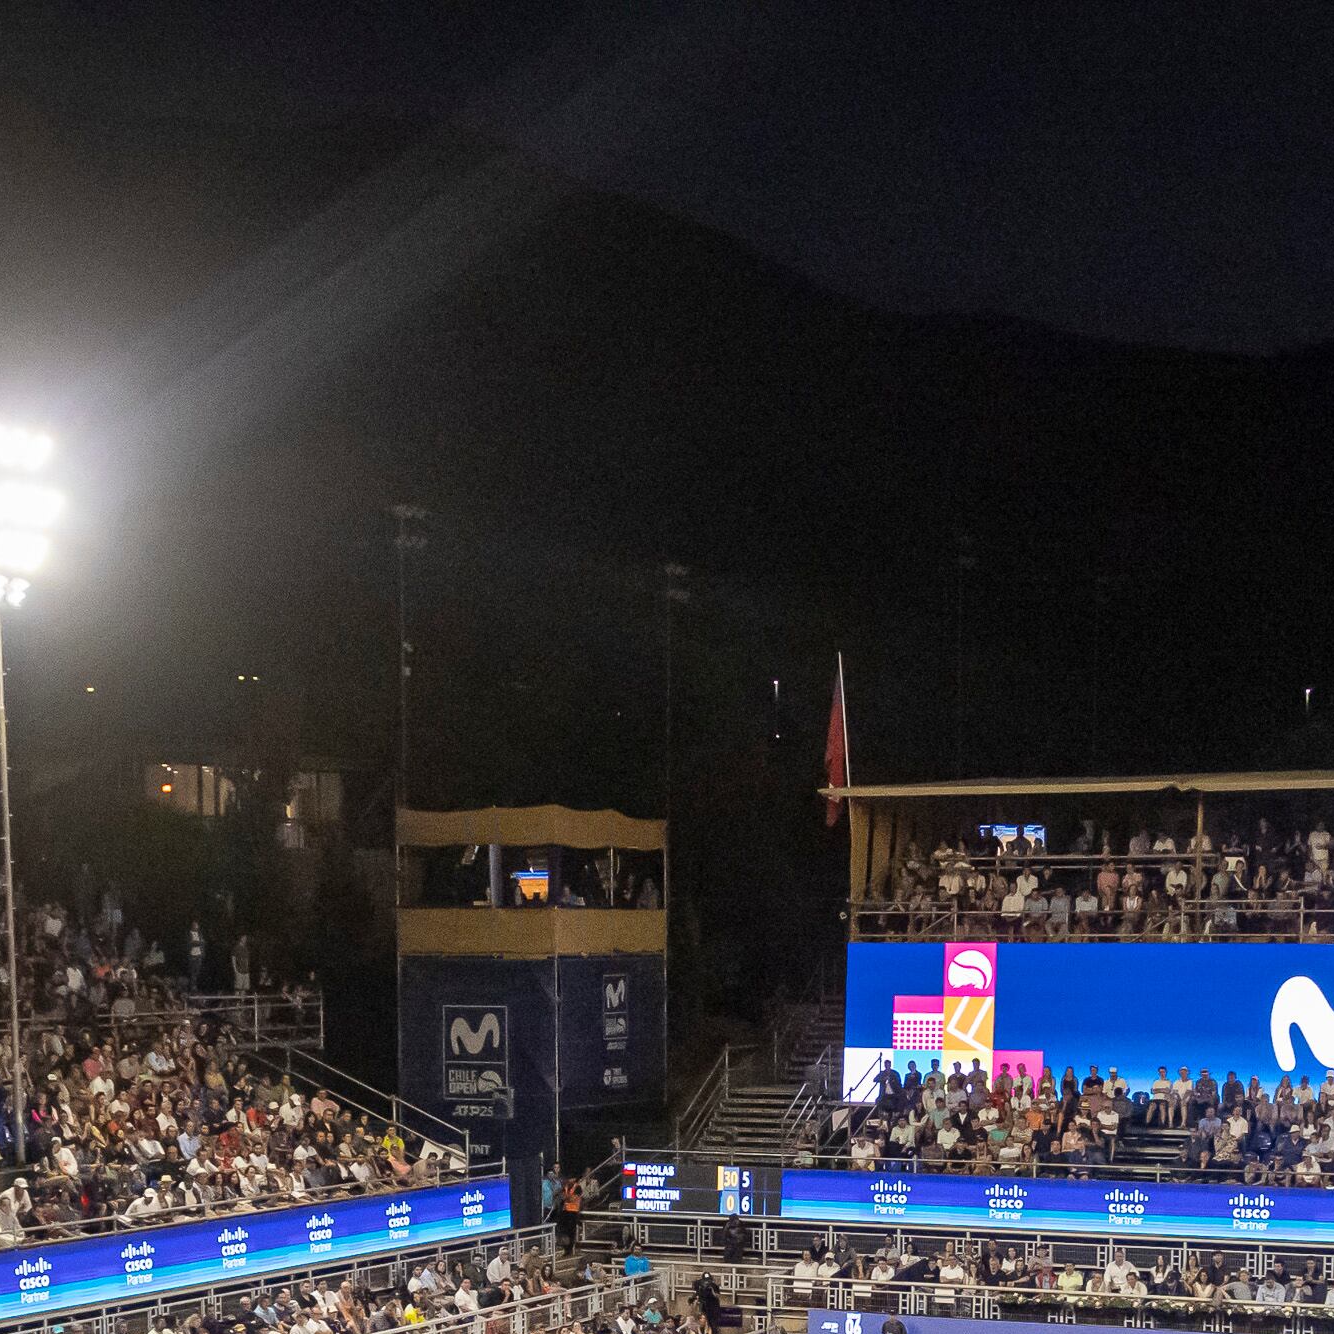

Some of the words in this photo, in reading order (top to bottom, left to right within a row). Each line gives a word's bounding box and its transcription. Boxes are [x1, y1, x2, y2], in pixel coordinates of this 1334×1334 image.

[448, 1070, 477, 1083] CHILE
[449, 1082, 478, 1094] OPEN
[452, 1104, 494, 1117] ATP25
[636, 1176, 666, 1187] JARRY
[637, 1165, 674, 1176] NICOLAS
[724, 1170, 737, 1186] 30
[742, 1171, 750, 1188] 5
[636, 1189, 679, 1200] CORENTIN
[727, 1195, 734, 1211] 0
[741, 1196, 750, 1212] 6
[873, 1193, 907, 1204] CISCO
[988, 1198, 1024, 1209] CISCO
[463, 1204, 483, 1216] CISCO
[636, 1200, 670, 1210] MOUTET
[874, 1205, 906, 1216] Partner
[1108, 1203, 1145, 1214] CISCO
[989, 1209, 1022, 1220] Partner
[1108, 1214, 1144, 1225] Partner
[1233, 1208, 1270, 1219] CISCO
[389, 1216, 410, 1229] CISCO
[463, 1215, 483, 1227] Partner
[1233, 1219, 1269, 1231] Partner
[309, 1228, 332, 1242] CISCO
[389, 1228, 409, 1240] Partner
[221, 1242, 247, 1257] CISCO
[310, 1242, 332, 1254] Partner
[125, 1258, 153, 1273] CISCO
[222, 1256, 247, 1270] Partner
[19, 1275, 50, 1290] CISCO
[126, 1272, 153, 1286] Partner
[21, 1290, 50, 1304] Partner
